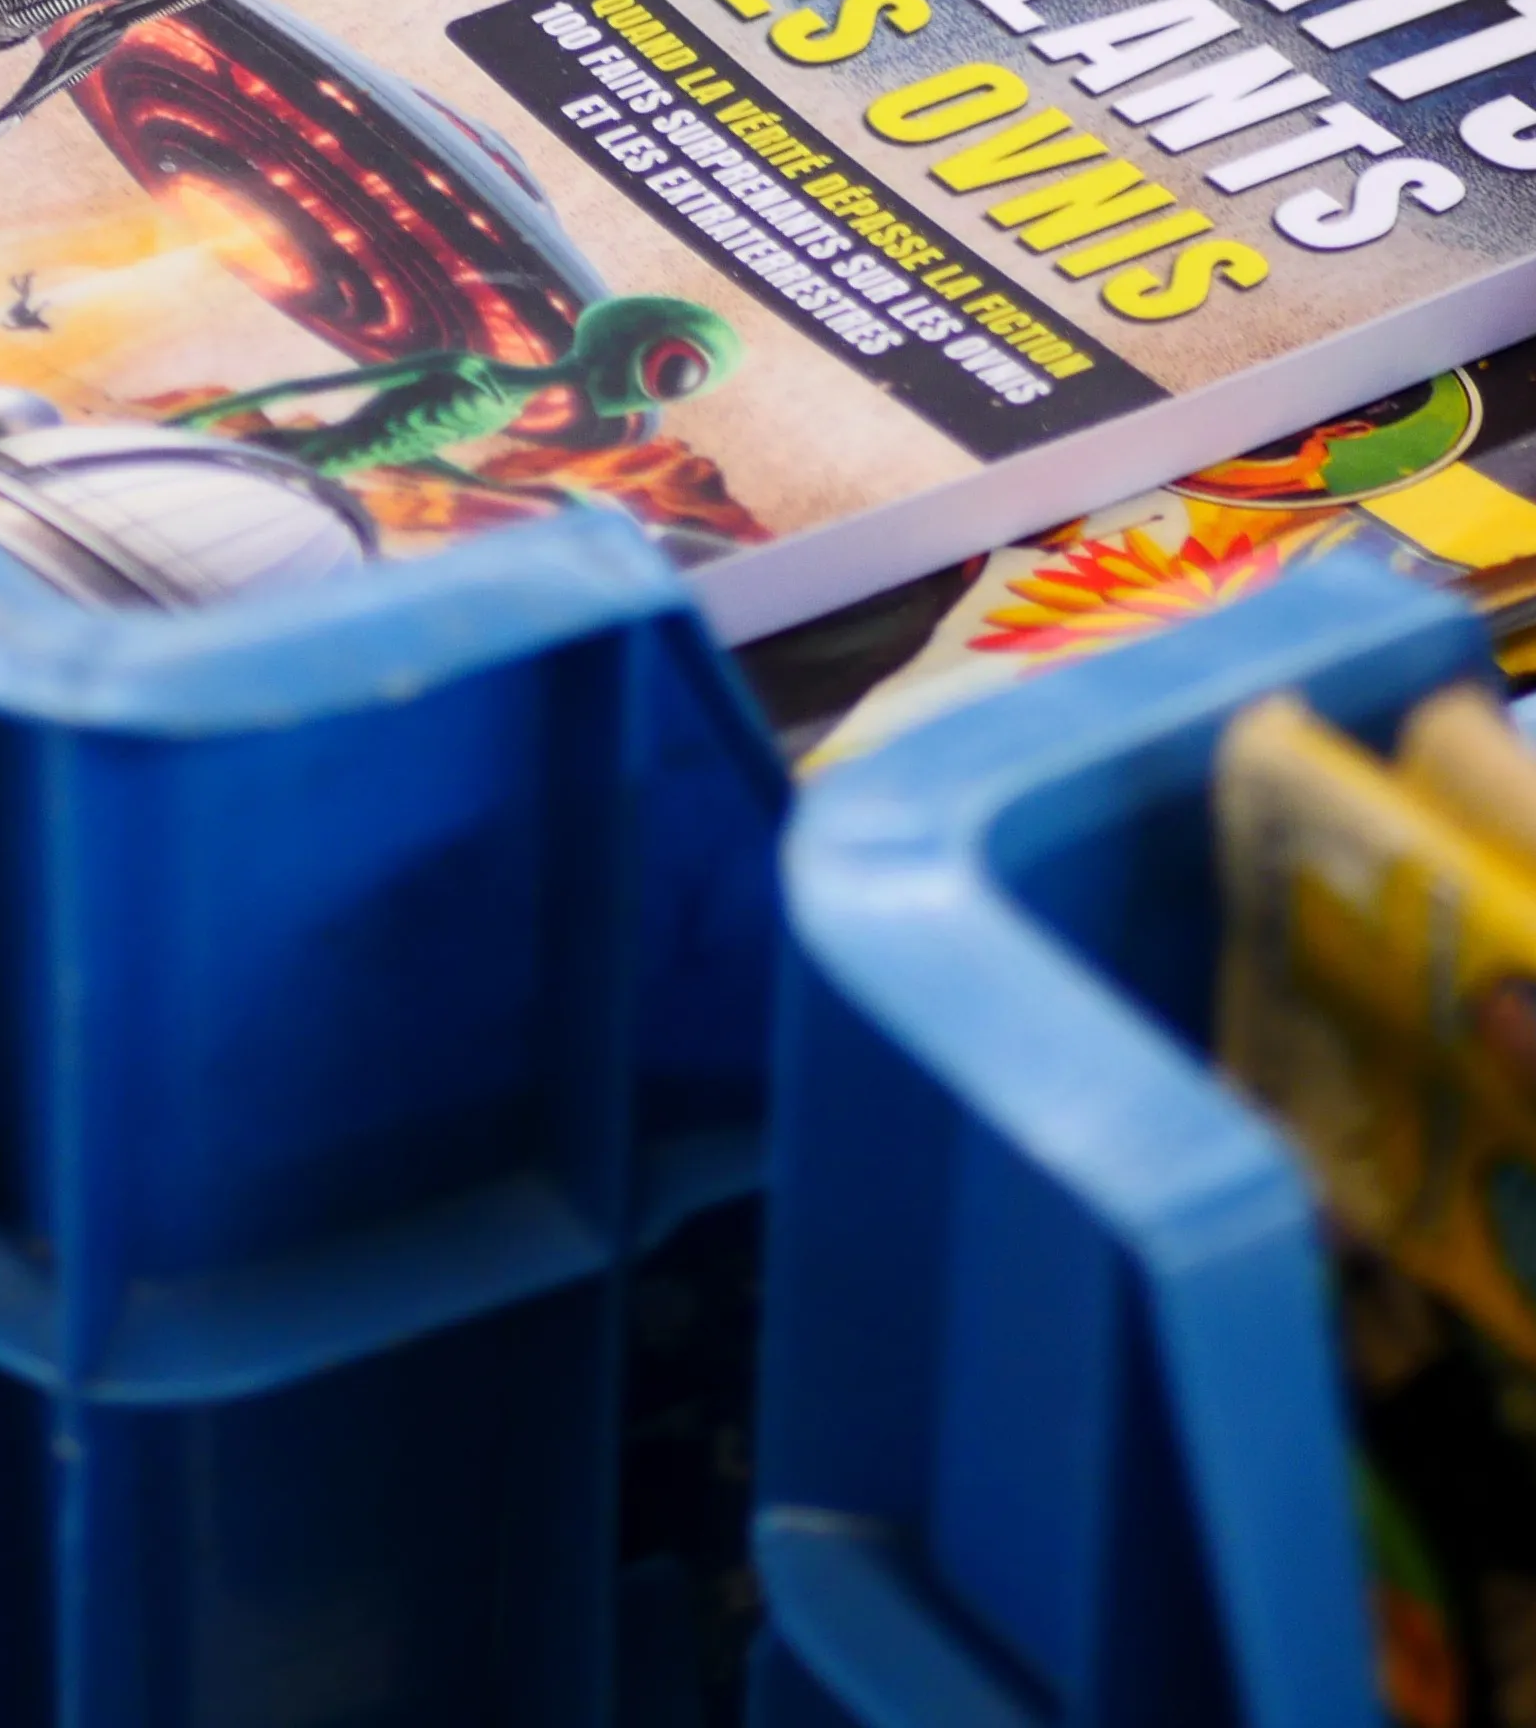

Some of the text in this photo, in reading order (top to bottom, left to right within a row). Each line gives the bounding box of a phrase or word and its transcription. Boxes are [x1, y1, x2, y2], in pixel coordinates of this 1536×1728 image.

[531, 1, 1053, 404] 100 FAITS SURPRENANTS SUR LES OVNIS
[560, 94, 906, 355] ET LES EXTRATERRESTRES
[675, 67, 736, 106] LA
[715, 98, 834, 180] VÉRITÉ
[802, 172, 946, 272] DÉPASSE
[921, 263, 983, 301] LA
[962, 292, 1095, 379] FICTION
[864, 61, 1269, 321] OVNIS
